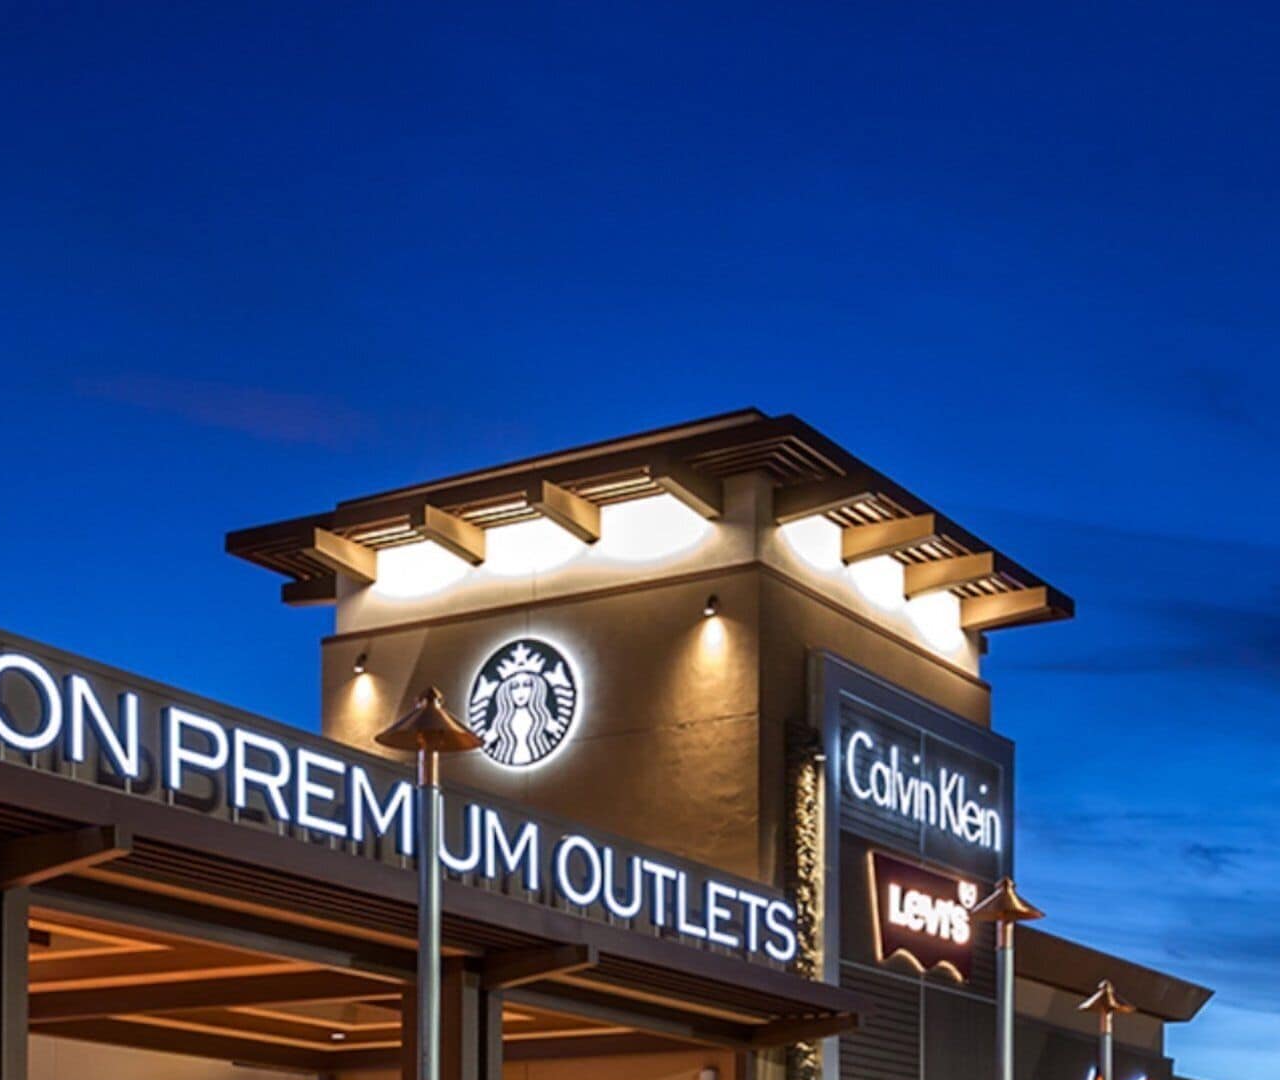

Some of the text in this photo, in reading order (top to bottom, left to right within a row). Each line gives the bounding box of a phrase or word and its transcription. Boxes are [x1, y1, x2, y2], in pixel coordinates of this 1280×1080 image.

[166, 706, 538, 891] PREMUM
[557, 834, 796, 961] OUTLETS
[846, 731, 1002, 853] Calvin Klein
